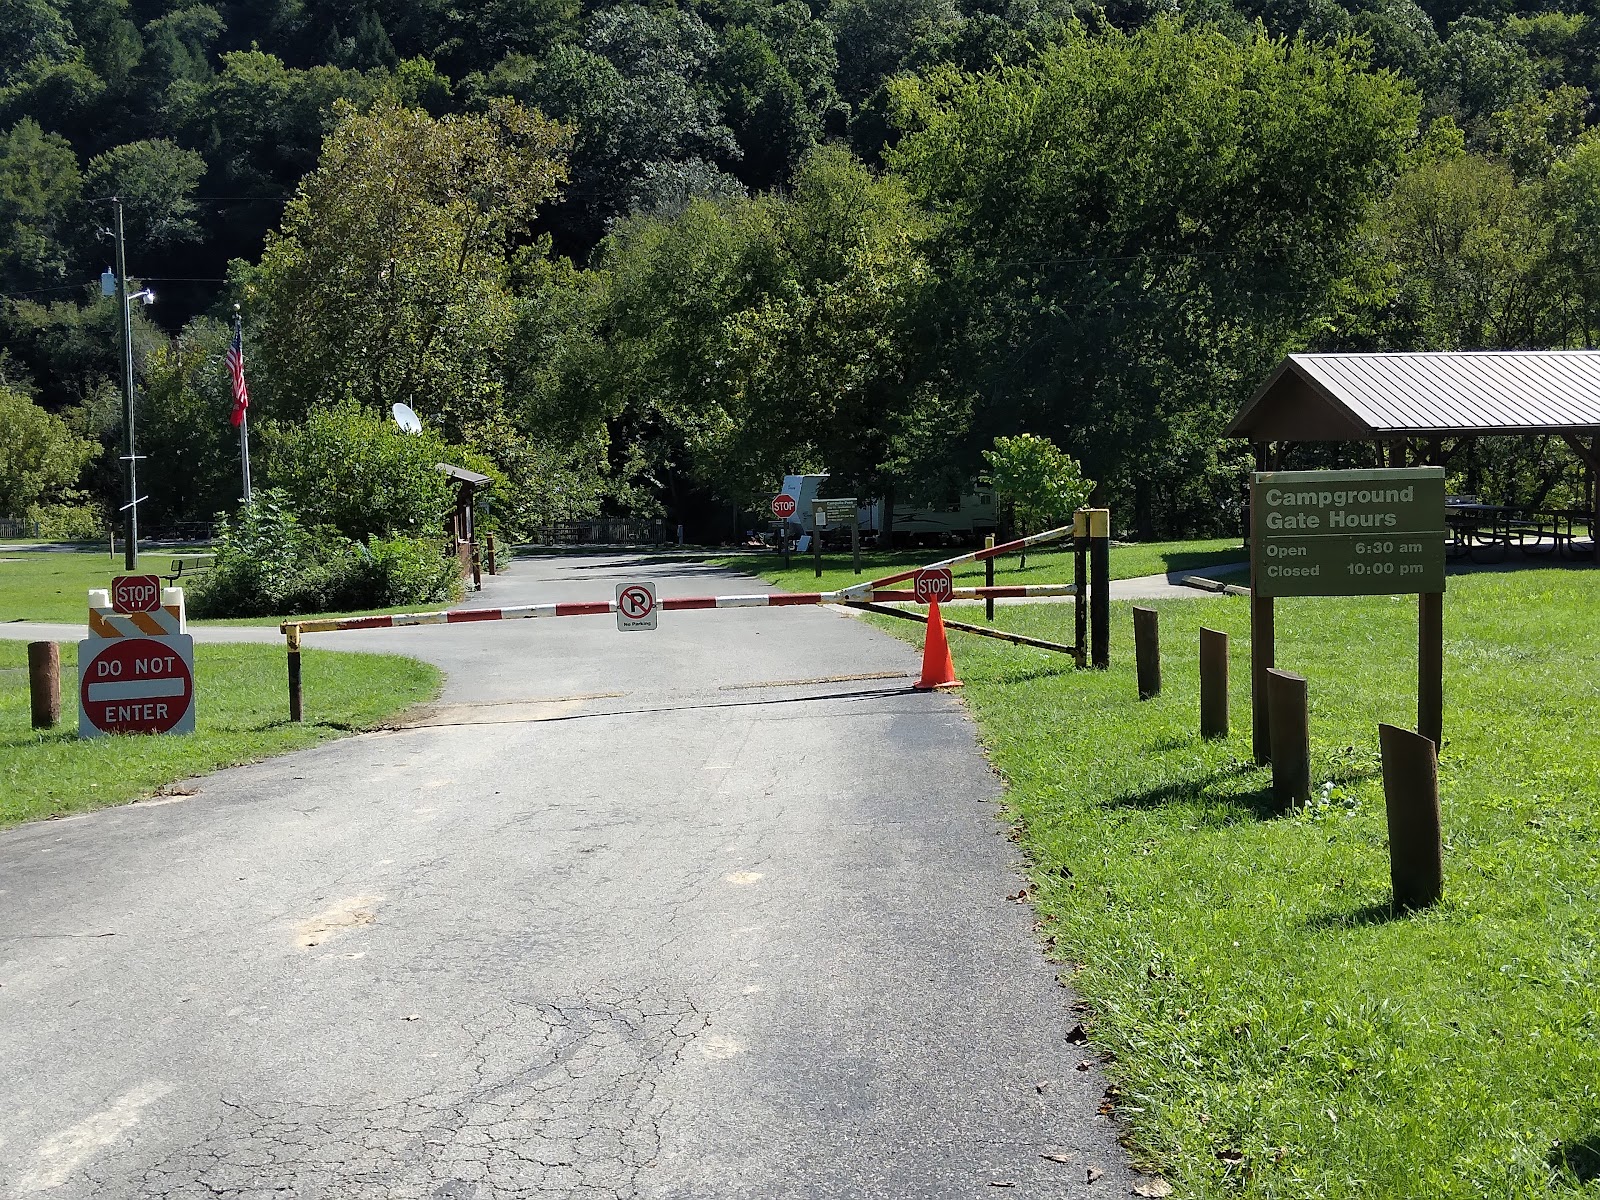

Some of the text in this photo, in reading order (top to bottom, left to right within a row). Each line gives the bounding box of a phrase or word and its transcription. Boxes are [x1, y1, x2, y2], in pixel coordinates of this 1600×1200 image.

[1266, 486, 1414, 508] Campground
[774, 501, 794, 512] STOP
[1266, 510, 1397, 530] Gate Hours
[1266, 541, 1423, 559] Open 6:30 am
[1267, 563, 1424, 578] Closed 10:00 pm
[118, 586, 154, 602] STOP
[919, 578, 948, 594] STOP
[97, 657, 175, 677] DO NOT
[105, 703, 168, 723] ENTER
